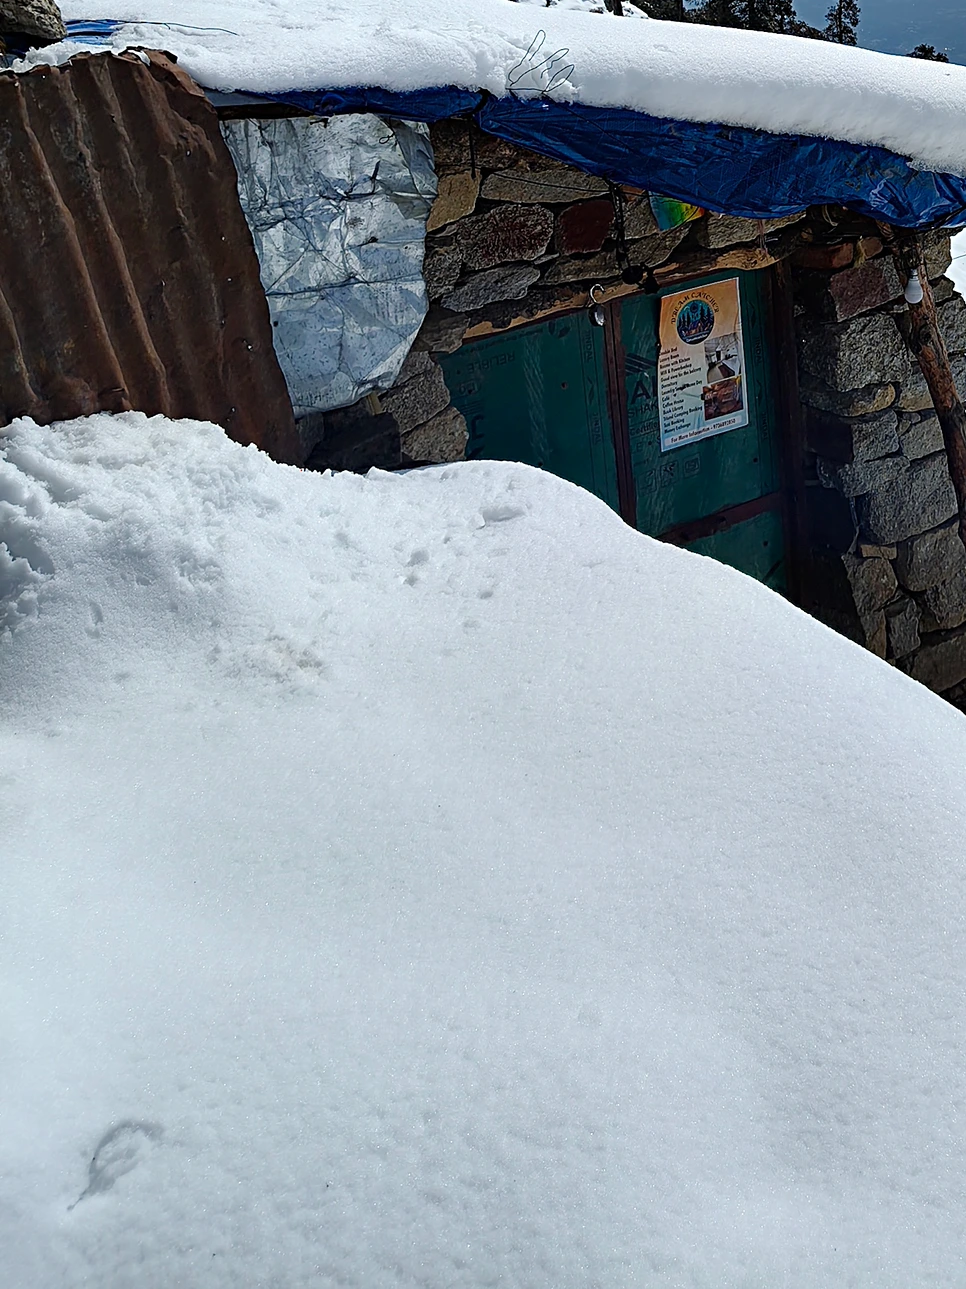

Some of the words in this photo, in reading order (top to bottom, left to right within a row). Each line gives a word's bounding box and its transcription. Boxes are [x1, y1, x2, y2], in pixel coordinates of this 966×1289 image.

[671, 295, 690, 325] DREAM
[691, 291, 720, 313] CATCHER
[689, 427, 710, 437] Information
